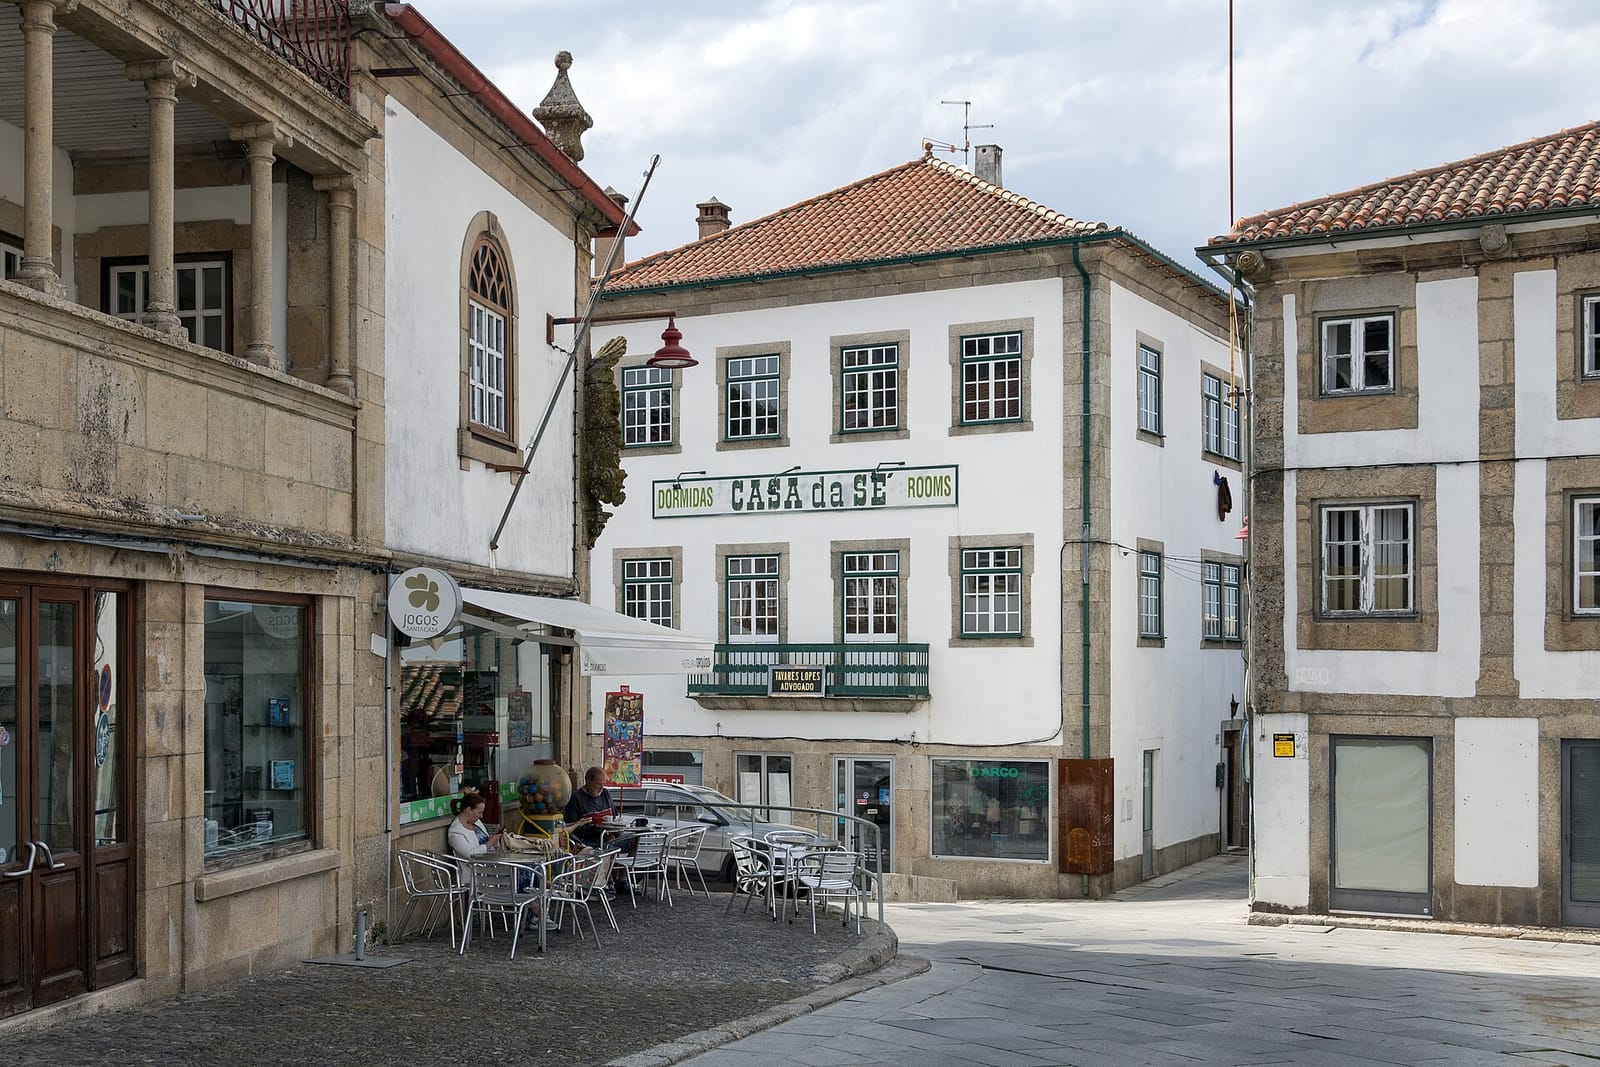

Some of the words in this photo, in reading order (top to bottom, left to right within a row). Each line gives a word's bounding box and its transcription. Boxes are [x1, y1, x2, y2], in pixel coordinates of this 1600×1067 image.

[731, 477, 803, 511] CASA
[812, 476, 844, 508] da
[907, 475, 951, 498] ROOMS
[658, 487, 713, 509] DORMIDAS
[402, 614, 439, 628] JOGOS
[775, 671, 799, 681] TAVARES
[800, 671, 821, 681] LOPES
[780, 682, 815, 691] ADVOGADO
